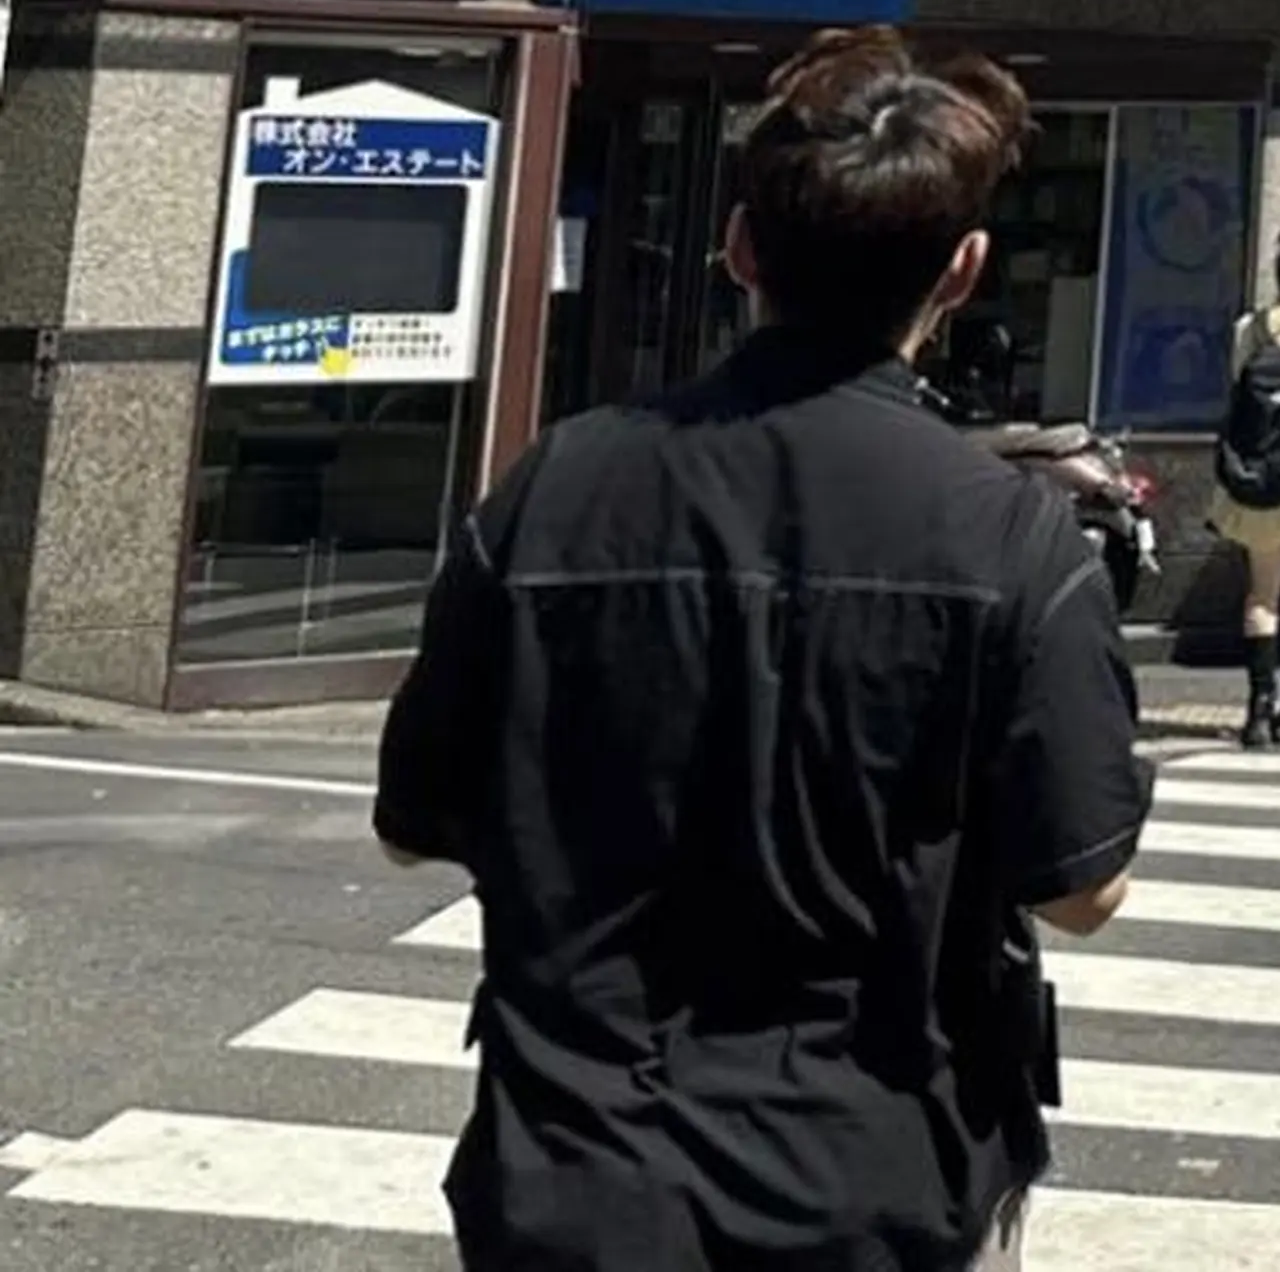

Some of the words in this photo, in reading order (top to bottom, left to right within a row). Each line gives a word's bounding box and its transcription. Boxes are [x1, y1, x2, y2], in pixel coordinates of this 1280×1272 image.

[254, 120, 357, 148] 株式会社
[282, 148, 482, 175] オン・エステート
